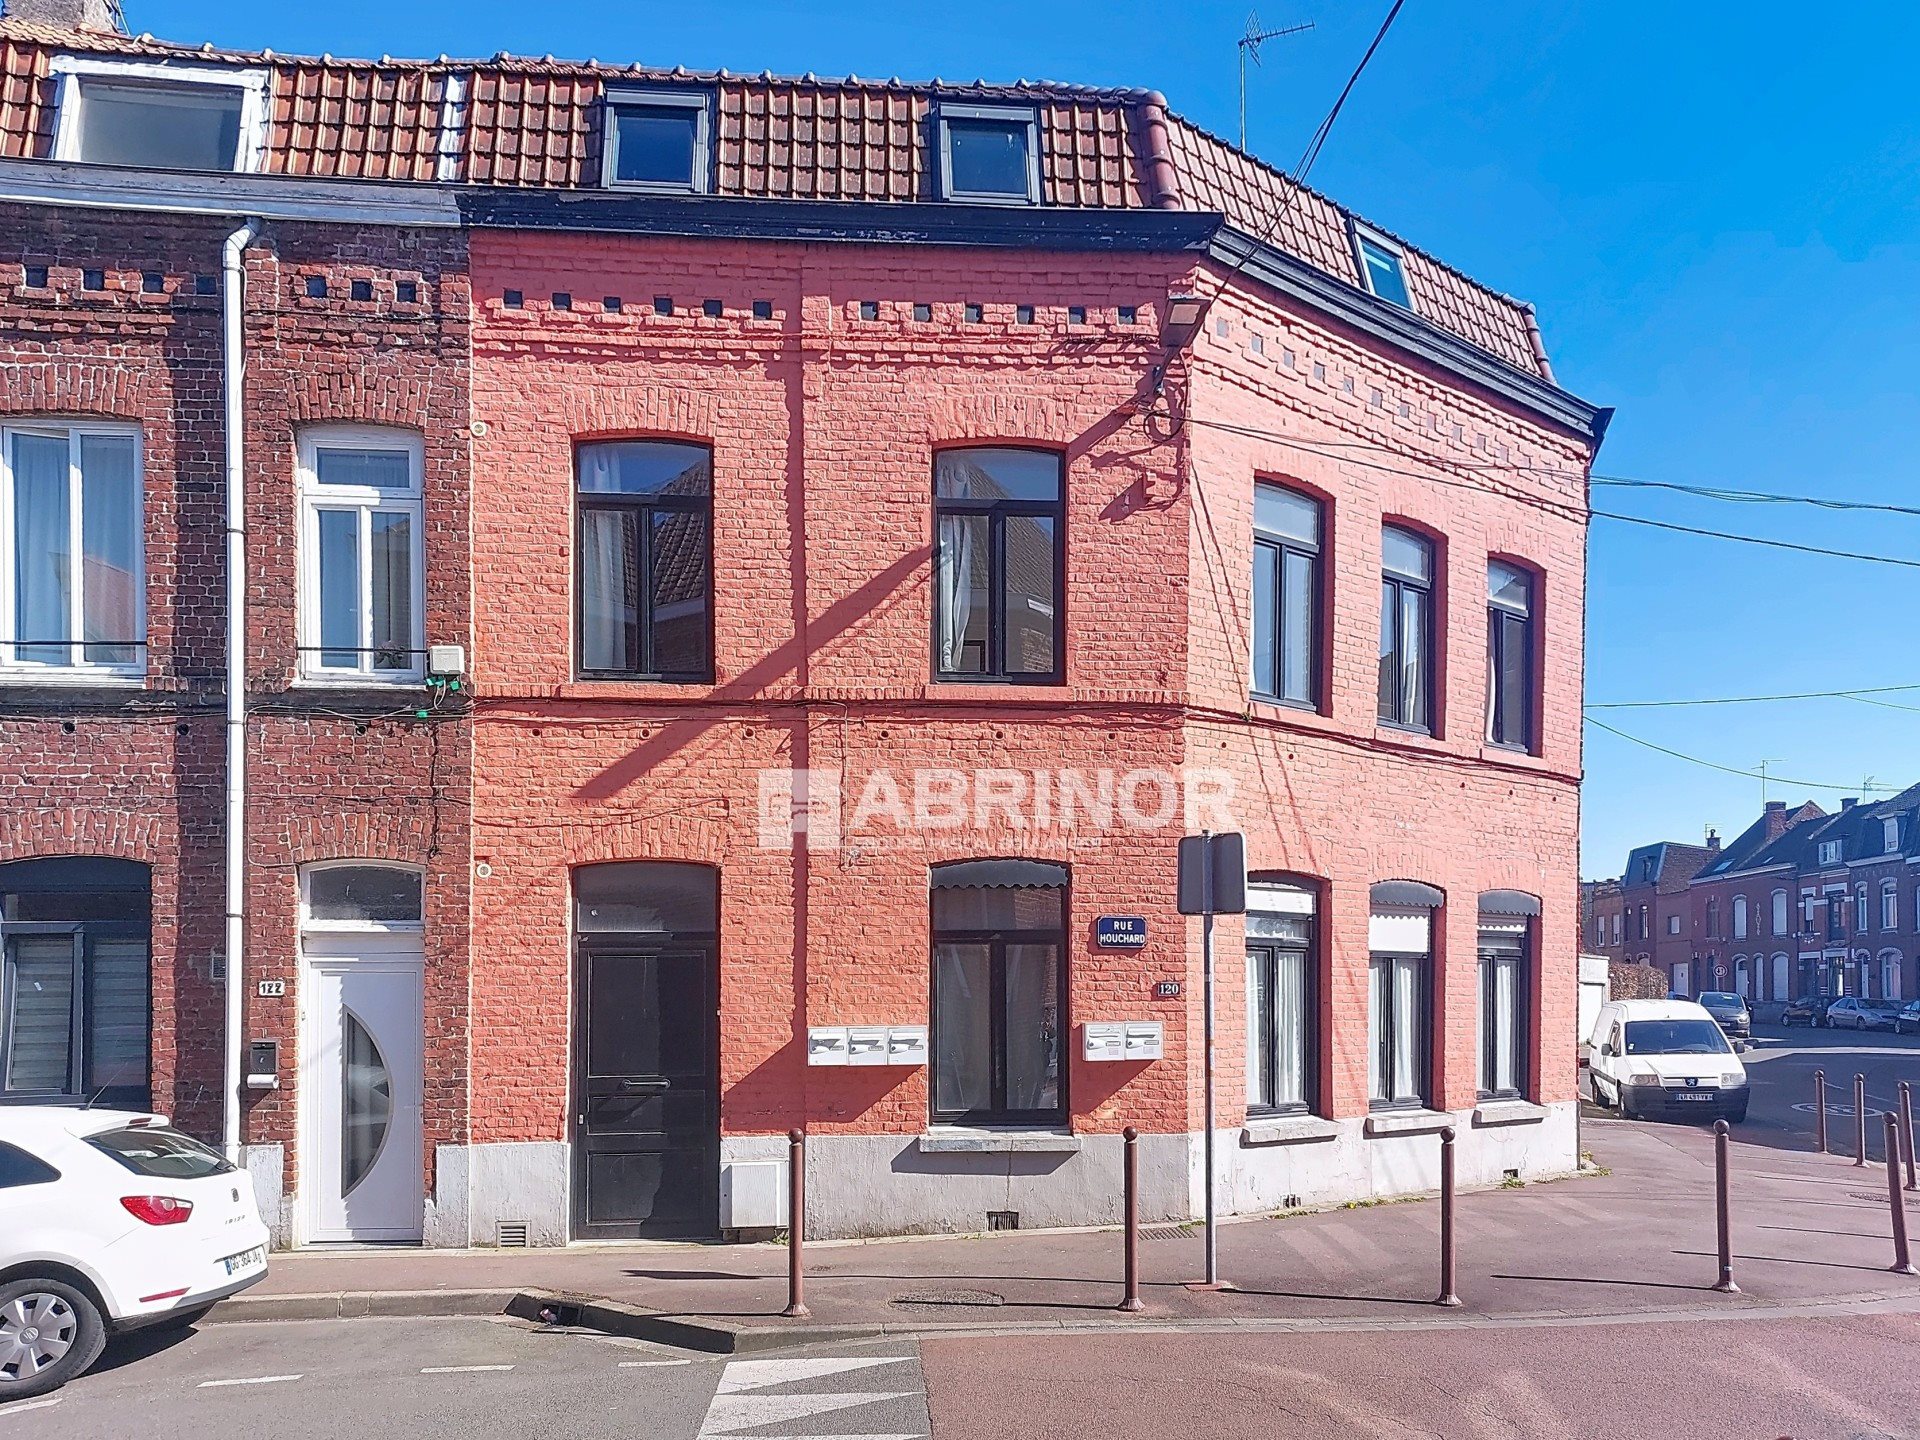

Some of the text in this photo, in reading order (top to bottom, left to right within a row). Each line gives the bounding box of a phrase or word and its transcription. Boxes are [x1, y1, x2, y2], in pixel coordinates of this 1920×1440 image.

[1113, 920, 1133, 931] RUE
[1100, 933, 1146, 944] HOUCHARD
[260, 982, 282, 994] 122
[1160, 984, 1179, 995] 120
